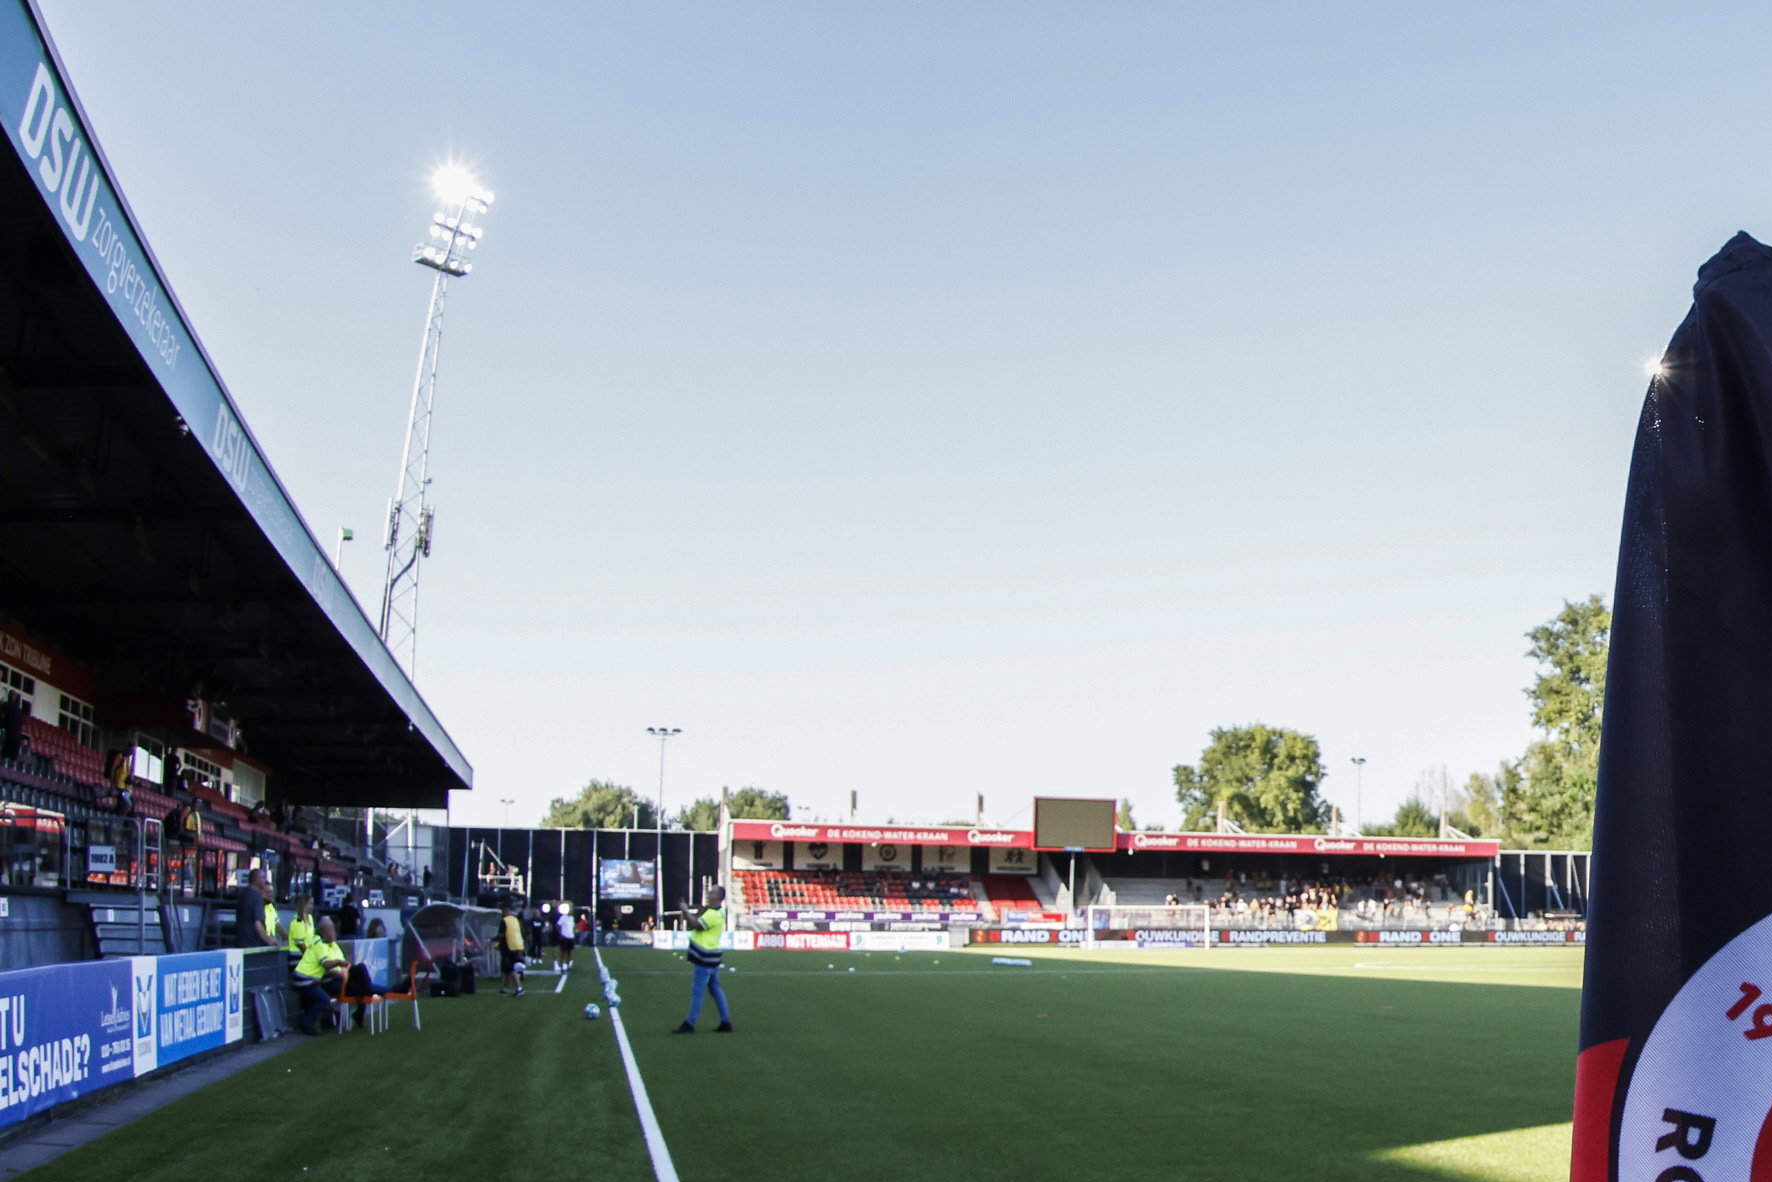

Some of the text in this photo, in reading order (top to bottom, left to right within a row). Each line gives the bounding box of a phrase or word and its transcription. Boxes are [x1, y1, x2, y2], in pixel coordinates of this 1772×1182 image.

[19, 62, 181, 372] DSW zorgverzekeraar
[213, 403, 252, 492] DSW
[756, 934, 785, 948] ARBO
[1127, 929, 1220, 942] BOUWKUNDIE
[12, 994, 25, 1047] U
[0, 1033, 91, 1111] ELSCHADE?
